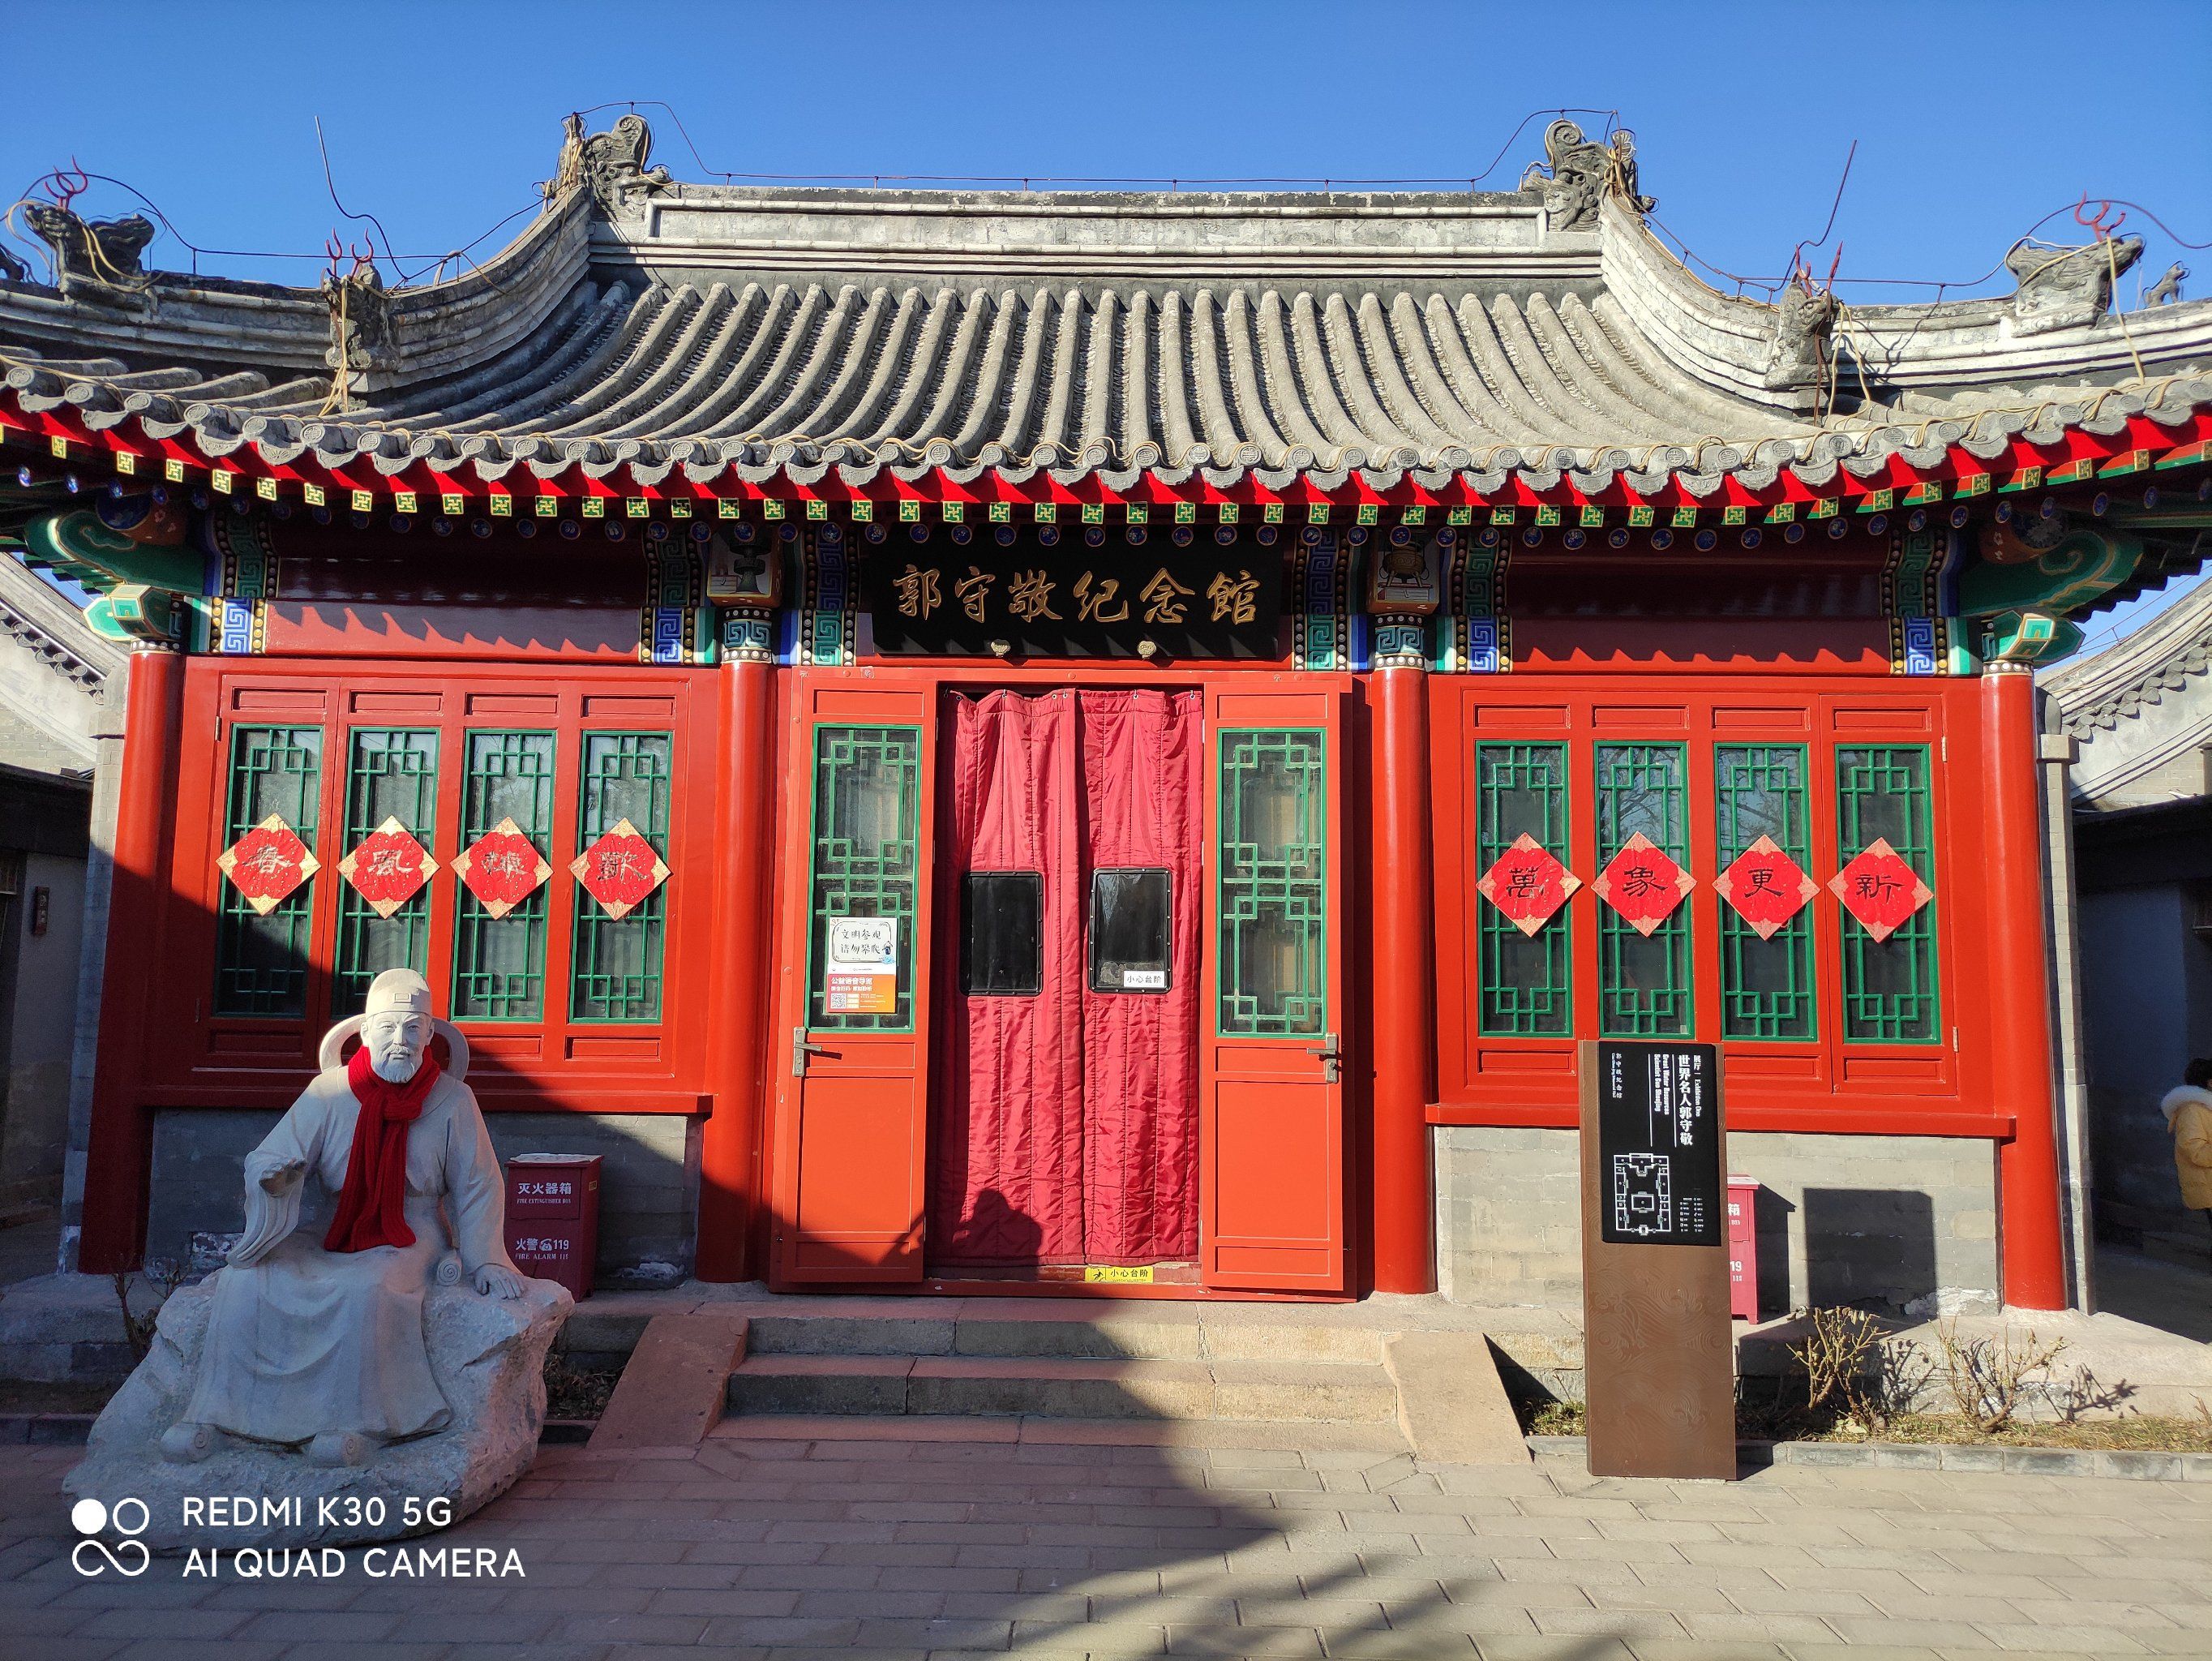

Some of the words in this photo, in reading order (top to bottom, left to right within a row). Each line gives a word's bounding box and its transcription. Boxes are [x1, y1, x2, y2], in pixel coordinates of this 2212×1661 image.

[242, 843, 294, 874] 春
[367, 849, 414, 877] 風
[1506, 866, 1545, 899] 萬
[1623, 865, 1667, 897] 象
[1744, 868, 1785, 899] 更
[1855, 873, 1905, 903] 新
[841, 929, 881, 940] 文明参观
[841, 943, 881, 955] 请勿攀爬
[1127, 975, 1162, 983] 小心台阶
[1678, 1054, 1693, 1146] 世界名人郭守敬
[517, 1182, 572, 1195] 灭火器箱
[516, 1238, 538, 1251] 火警
[553, 1239, 569, 1250] 119
[1110, 1268, 1149, 1277] 小心台阶
